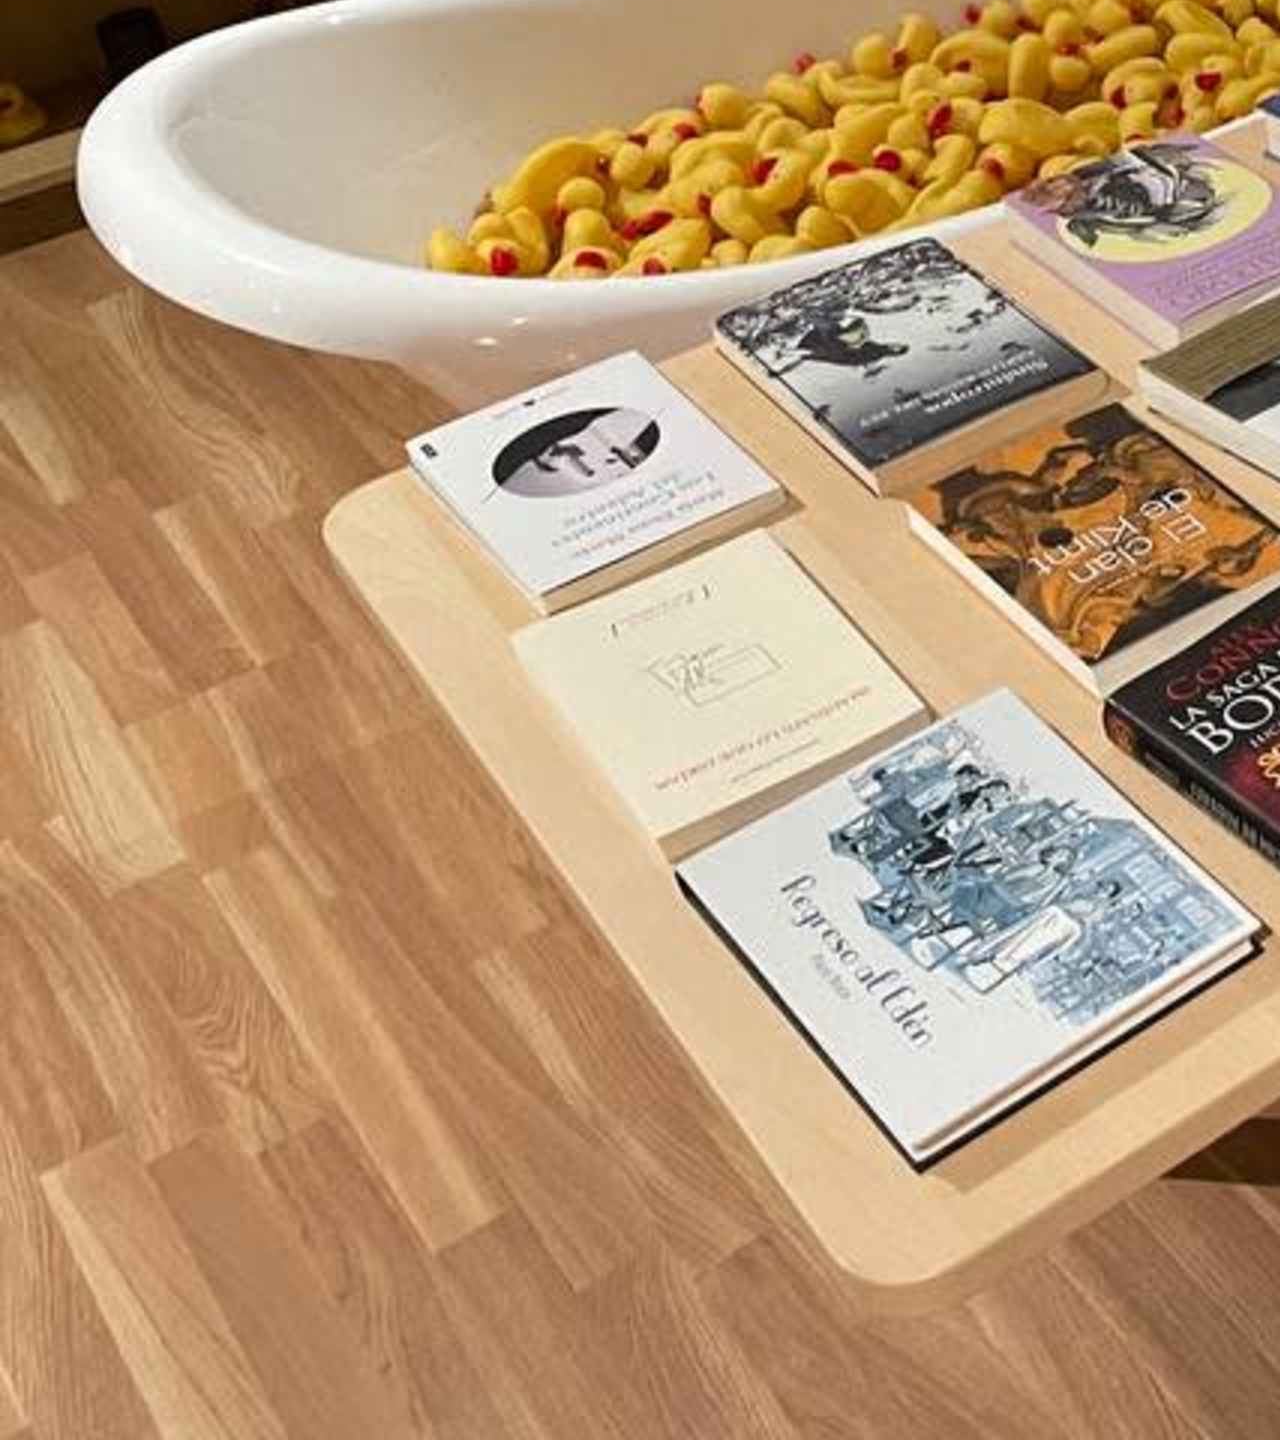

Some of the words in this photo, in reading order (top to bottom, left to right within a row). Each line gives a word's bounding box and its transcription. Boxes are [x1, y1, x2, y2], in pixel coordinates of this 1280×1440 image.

[1139, 486, 1194, 520] de
[1161, 516, 1207, 545] El
[1024, 514, 1138, 578] Klimt
[1070, 534, 1152, 586] clan
[1169, 706, 1204, 732] LA
[1205, 662, 1280, 707] SAGA
[780, 874, 860, 965] Regreso
